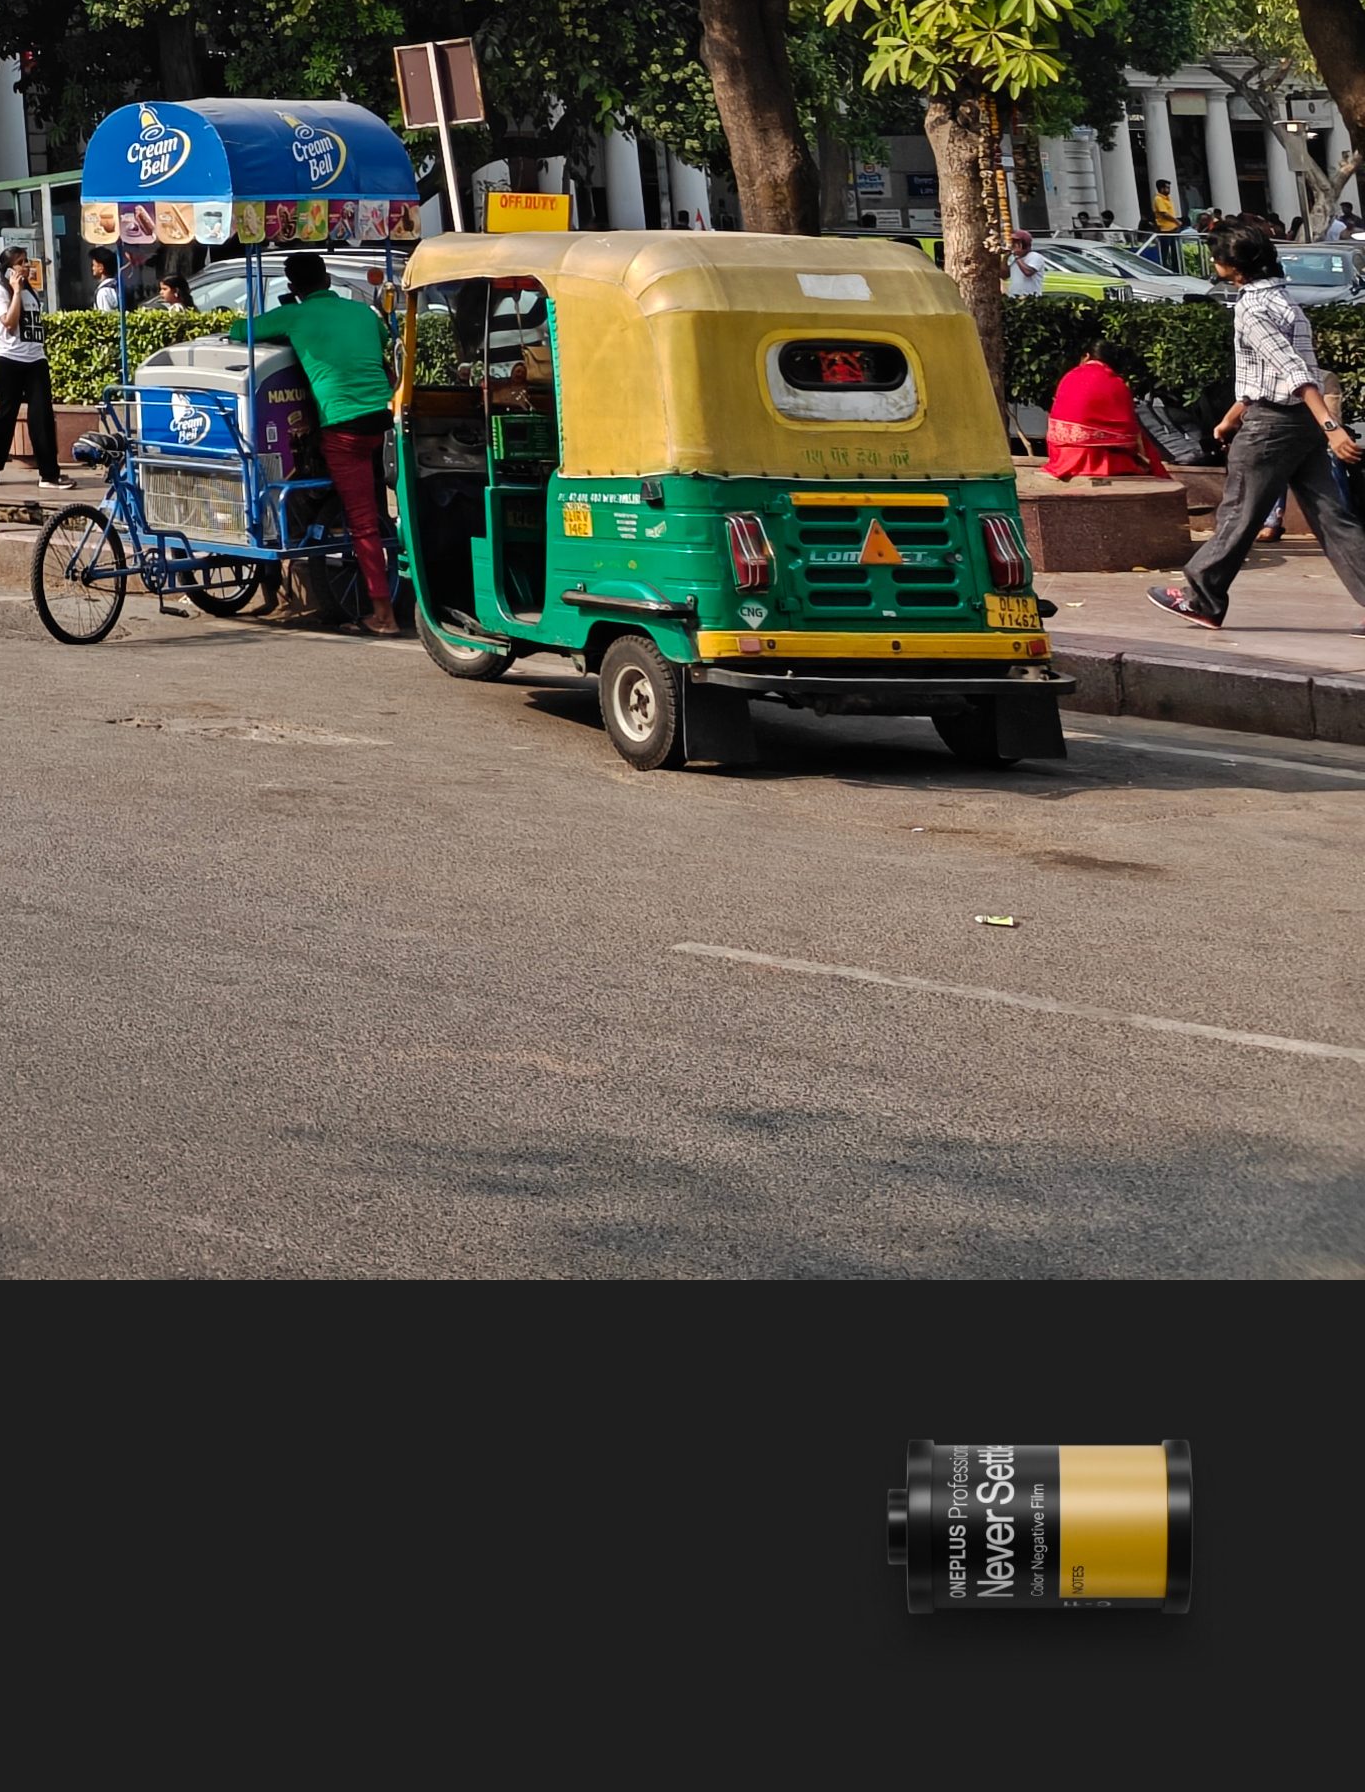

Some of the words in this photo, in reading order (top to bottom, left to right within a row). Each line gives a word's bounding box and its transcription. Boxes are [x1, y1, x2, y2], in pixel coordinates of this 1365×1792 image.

[127, 136, 178, 163] Cream
[292, 136, 333, 163] Cream
[139, 155, 169, 181] Bell
[308, 156, 333, 182] Bell
[169, 416, 203, 432] Cream
[178, 428, 198, 444] Bell
[740, 607, 763, 618] CNG
